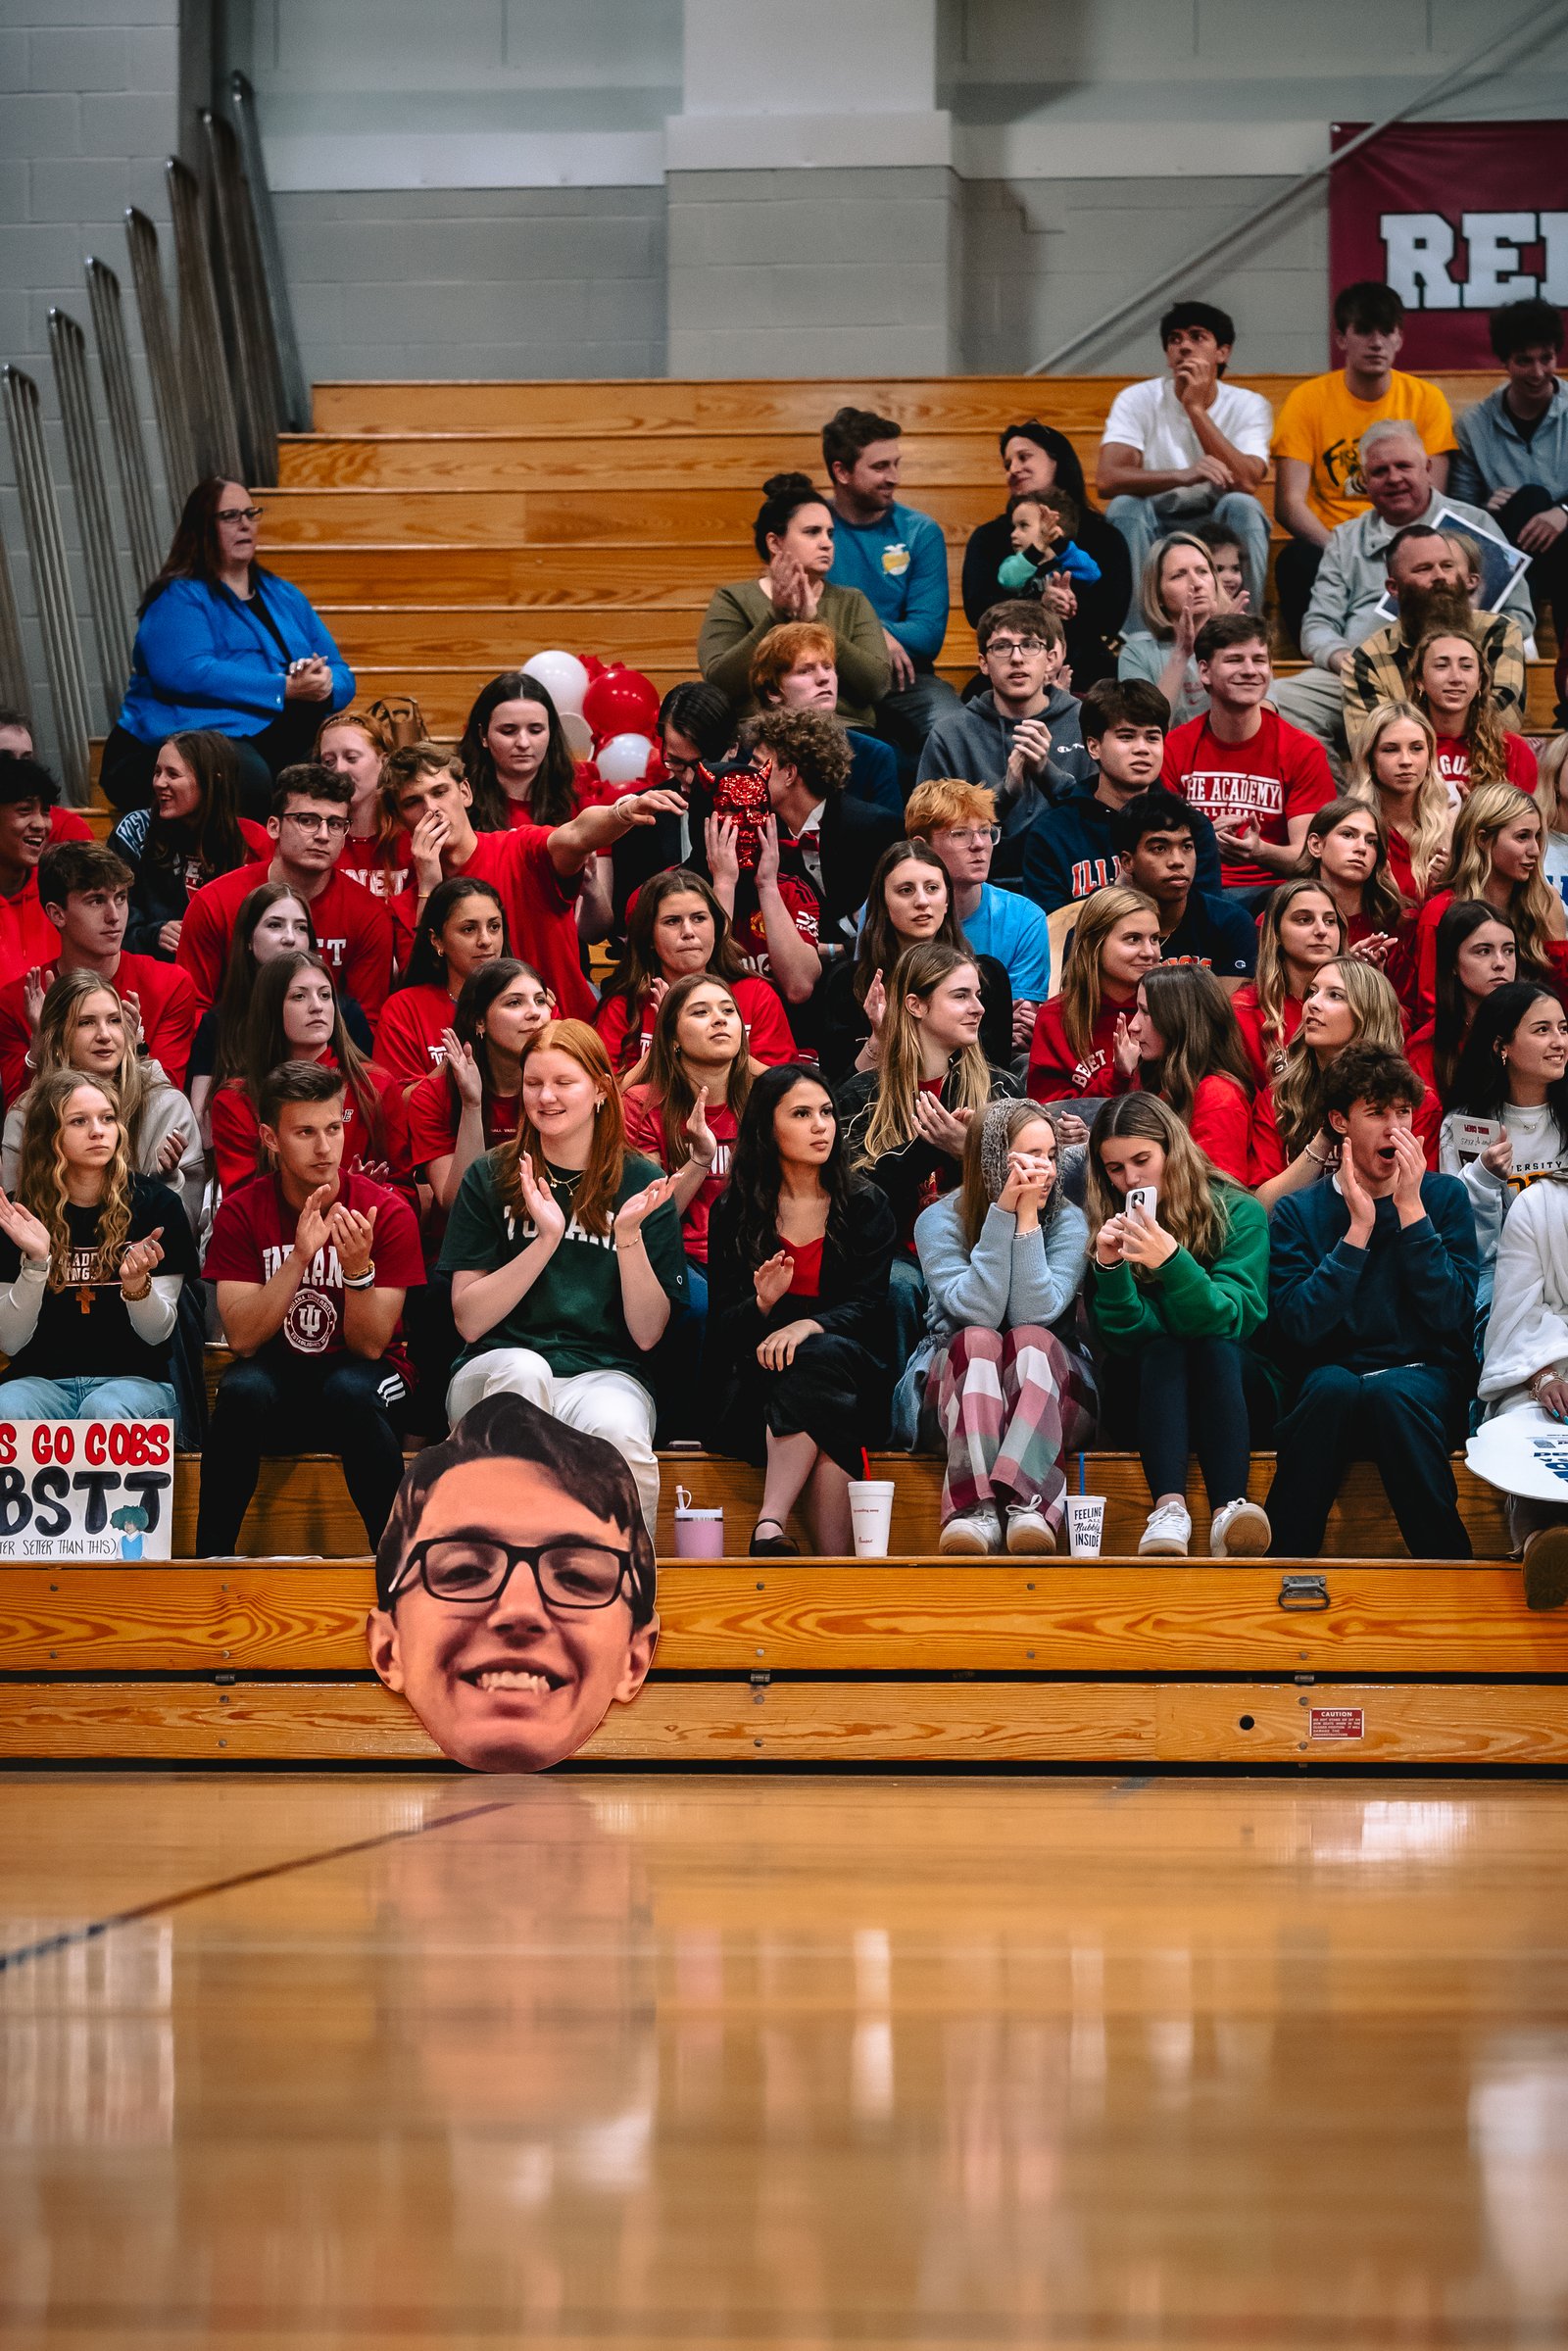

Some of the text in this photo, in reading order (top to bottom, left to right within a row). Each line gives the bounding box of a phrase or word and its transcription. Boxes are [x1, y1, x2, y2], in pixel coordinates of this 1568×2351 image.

[1439, 754, 1471, 776] GU
[1187, 777, 1281, 808] HE ACADEMY
[340, 868, 410, 898] NET
[1511, 1161, 1562, 1173] ERSITY
[32, 1424, 75, 1465] GO
[84, 1423, 171, 1466] COBS
[1074, 1506, 1102, 1520] FEELING
[23, 1540, 54, 1556] SETTER
[57, 1540, 84, 1555] THAN
[1075, 1533, 1100, 1547] INSIDE
